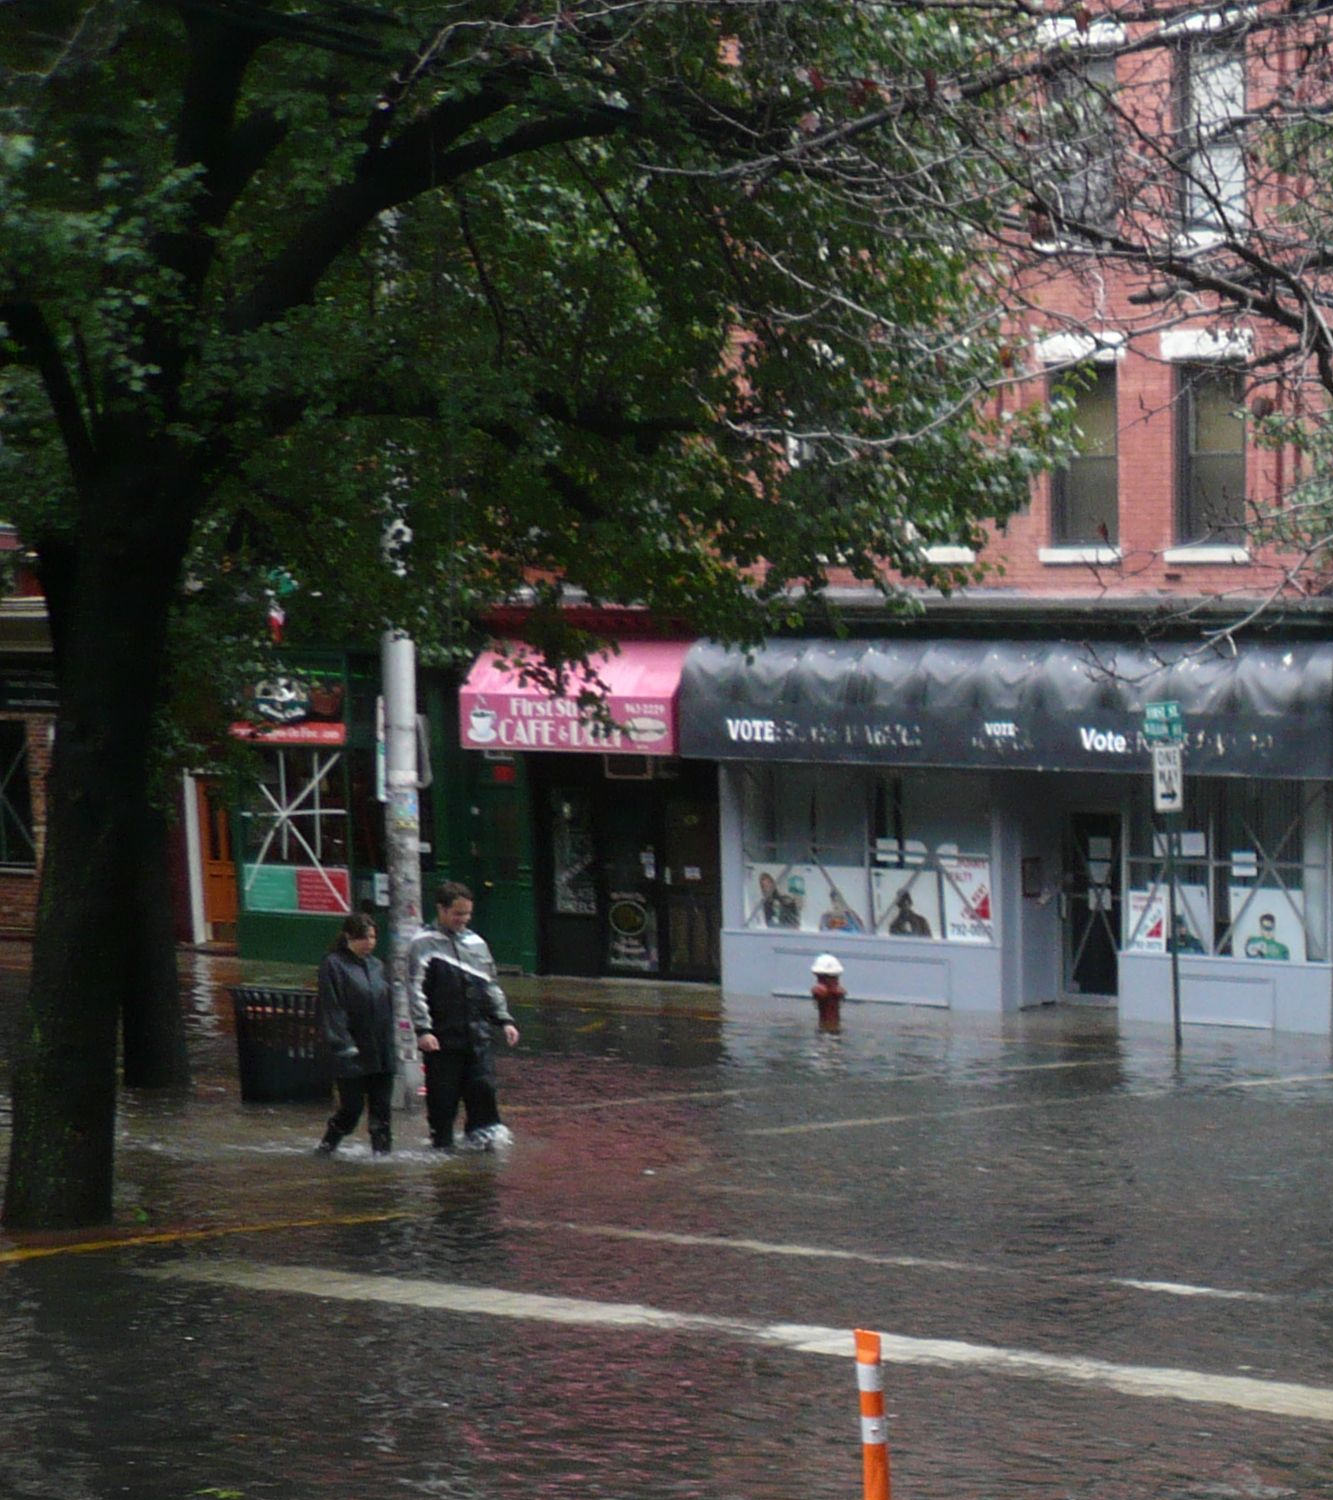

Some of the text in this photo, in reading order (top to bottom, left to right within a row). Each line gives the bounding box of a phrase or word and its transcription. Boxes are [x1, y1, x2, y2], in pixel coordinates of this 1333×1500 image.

[509, 697, 553, 717] First
[498, 718, 555, 746] CAFE
[558, 727, 570, 743] &
[1157, 750, 1179, 768] ONE
[1158, 769, 1180, 785] WAY
